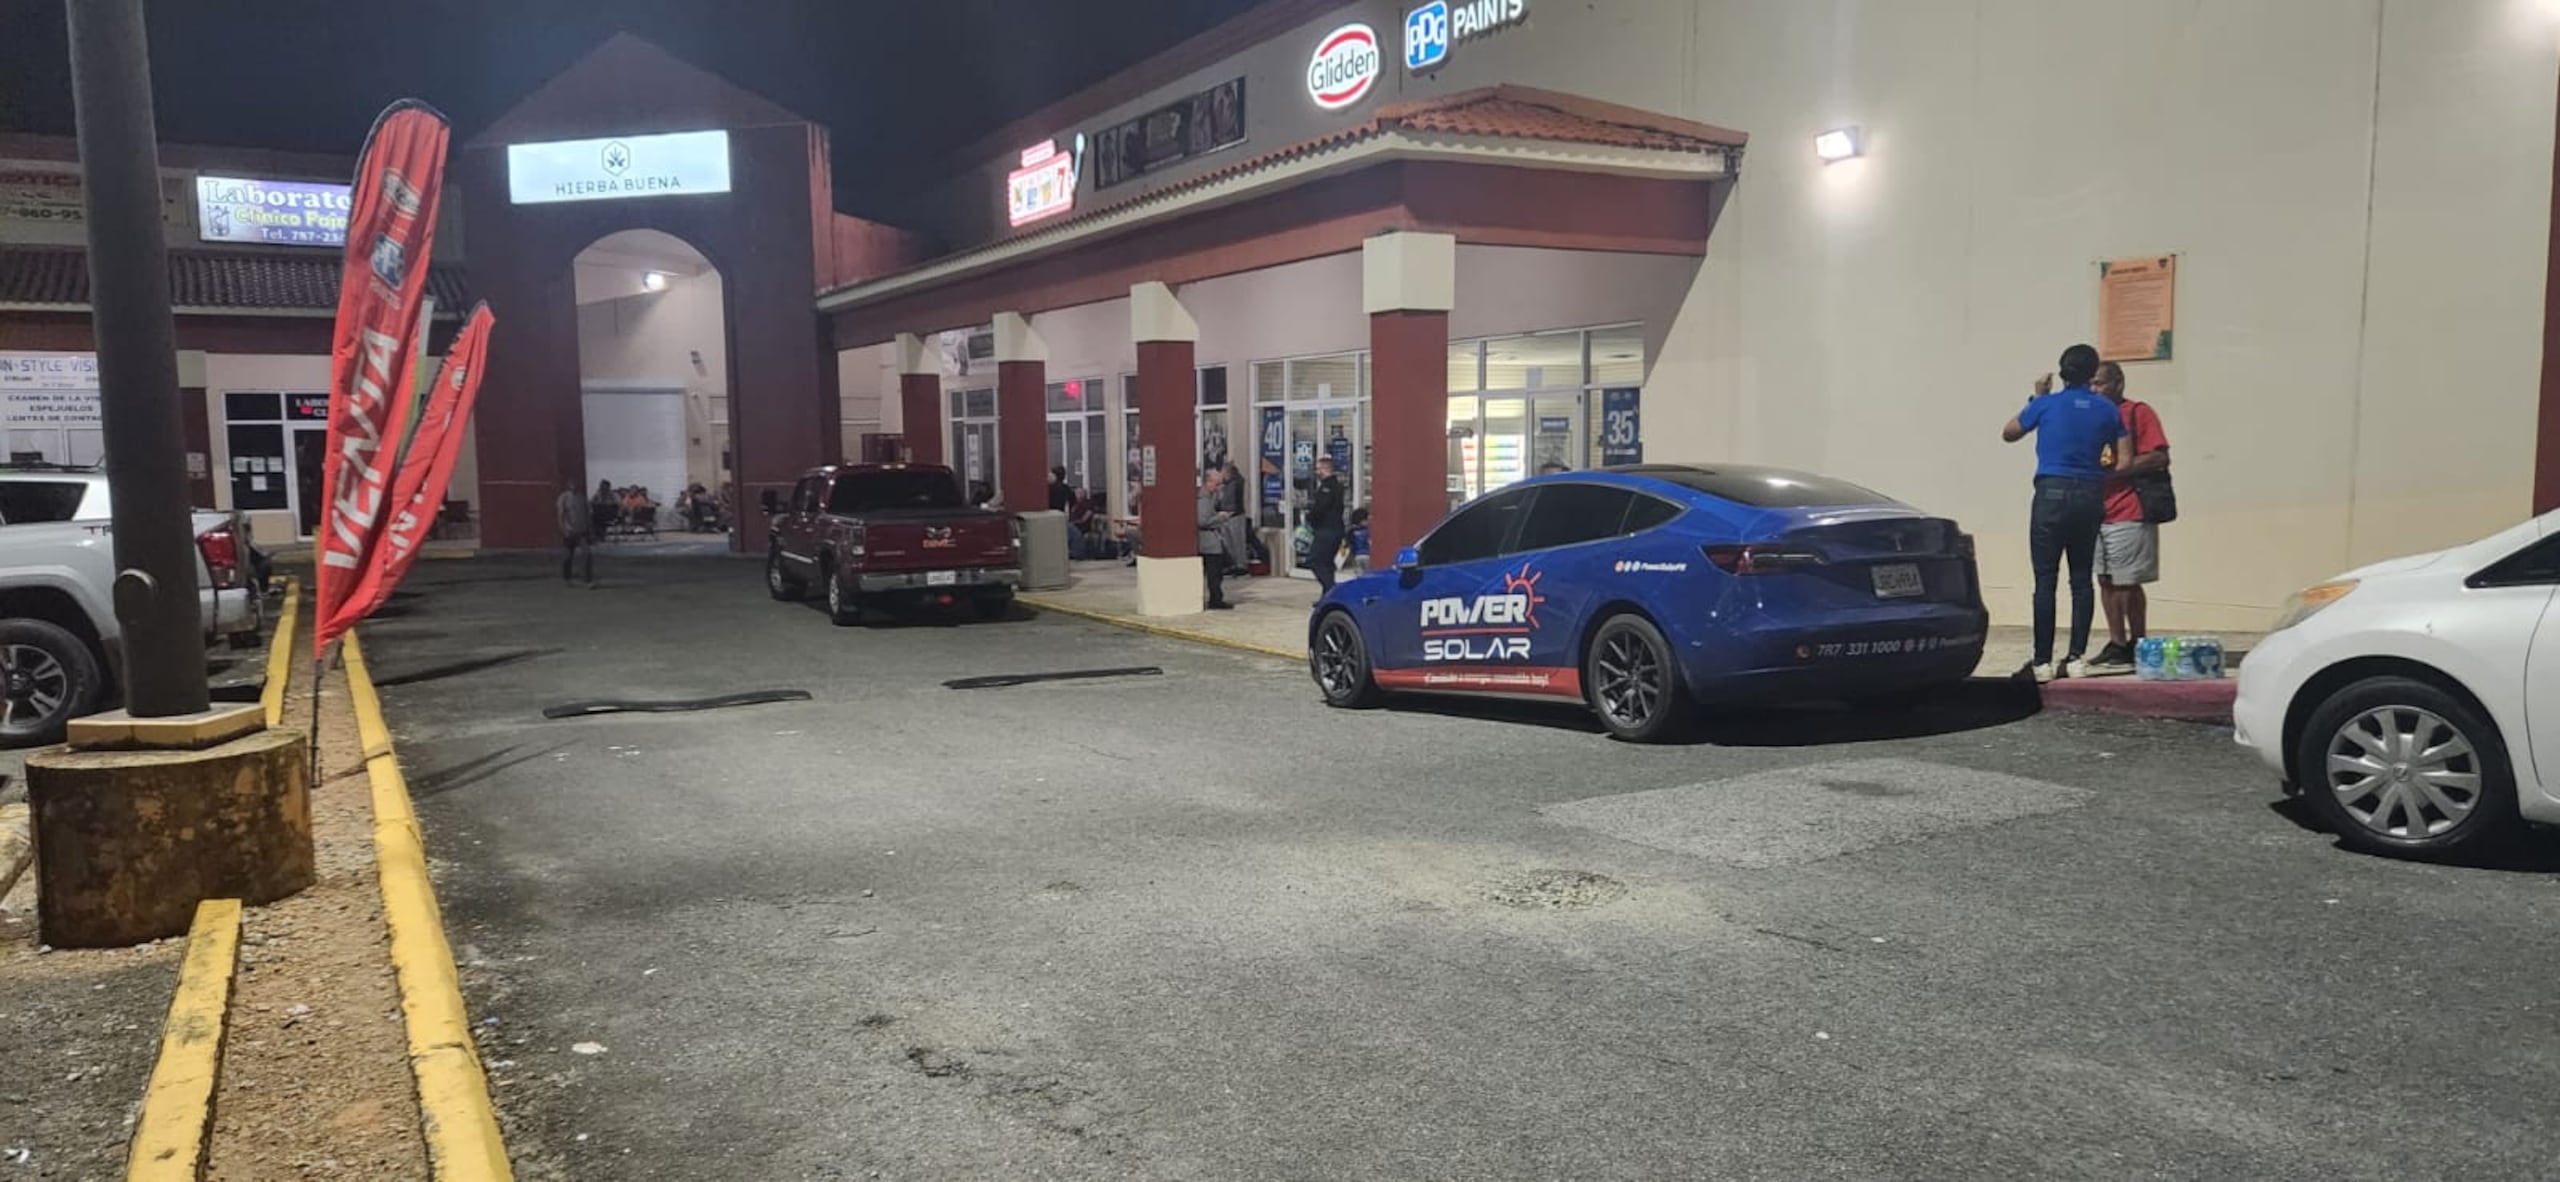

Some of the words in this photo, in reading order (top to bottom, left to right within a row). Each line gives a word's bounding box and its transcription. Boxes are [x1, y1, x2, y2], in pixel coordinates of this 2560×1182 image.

[1409, 12, 1445, 61] PPG
[1453, 0, 1523, 39] PAINTS
[1311, 49, 1377, 91] Glidden
[555, 180, 618, 195] HIERBA
[624, 176, 681, 191] BUENA
[323, 328, 399, 570] VENTA
[1420, 594, 1528, 627] POWER
[1423, 637, 1532, 661] SOLAR
[1818, 643, 1842, 656] 787
[1846, 642, 1869, 655] 331
[1871, 639, 1900, 654] 1000
